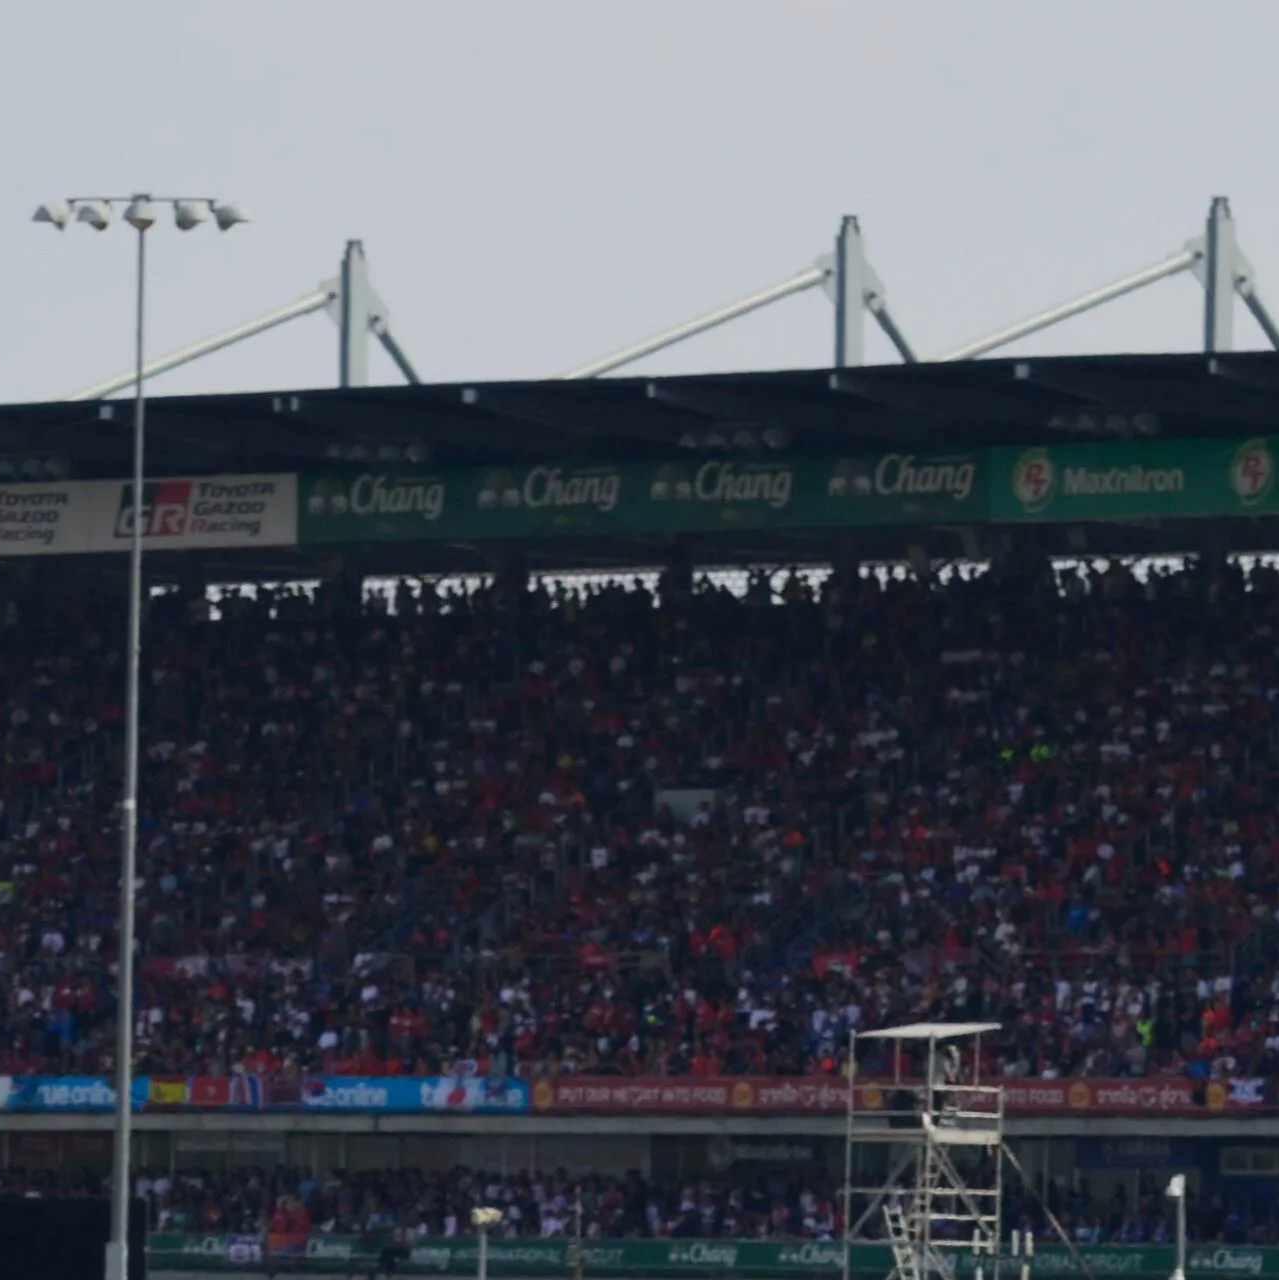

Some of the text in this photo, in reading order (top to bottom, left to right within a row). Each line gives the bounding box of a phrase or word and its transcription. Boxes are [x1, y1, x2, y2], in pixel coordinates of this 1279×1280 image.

[198, 481, 276, 499] TOYOTA
[350, 472, 445, 521] Chang
[523, 465, 622, 512] Chang
[694, 460, 795, 508] Chang
[875, 452, 976, 500] Chang
[190, 516, 262, 537] Racing
[194, 499, 266, 516] GAZOO
